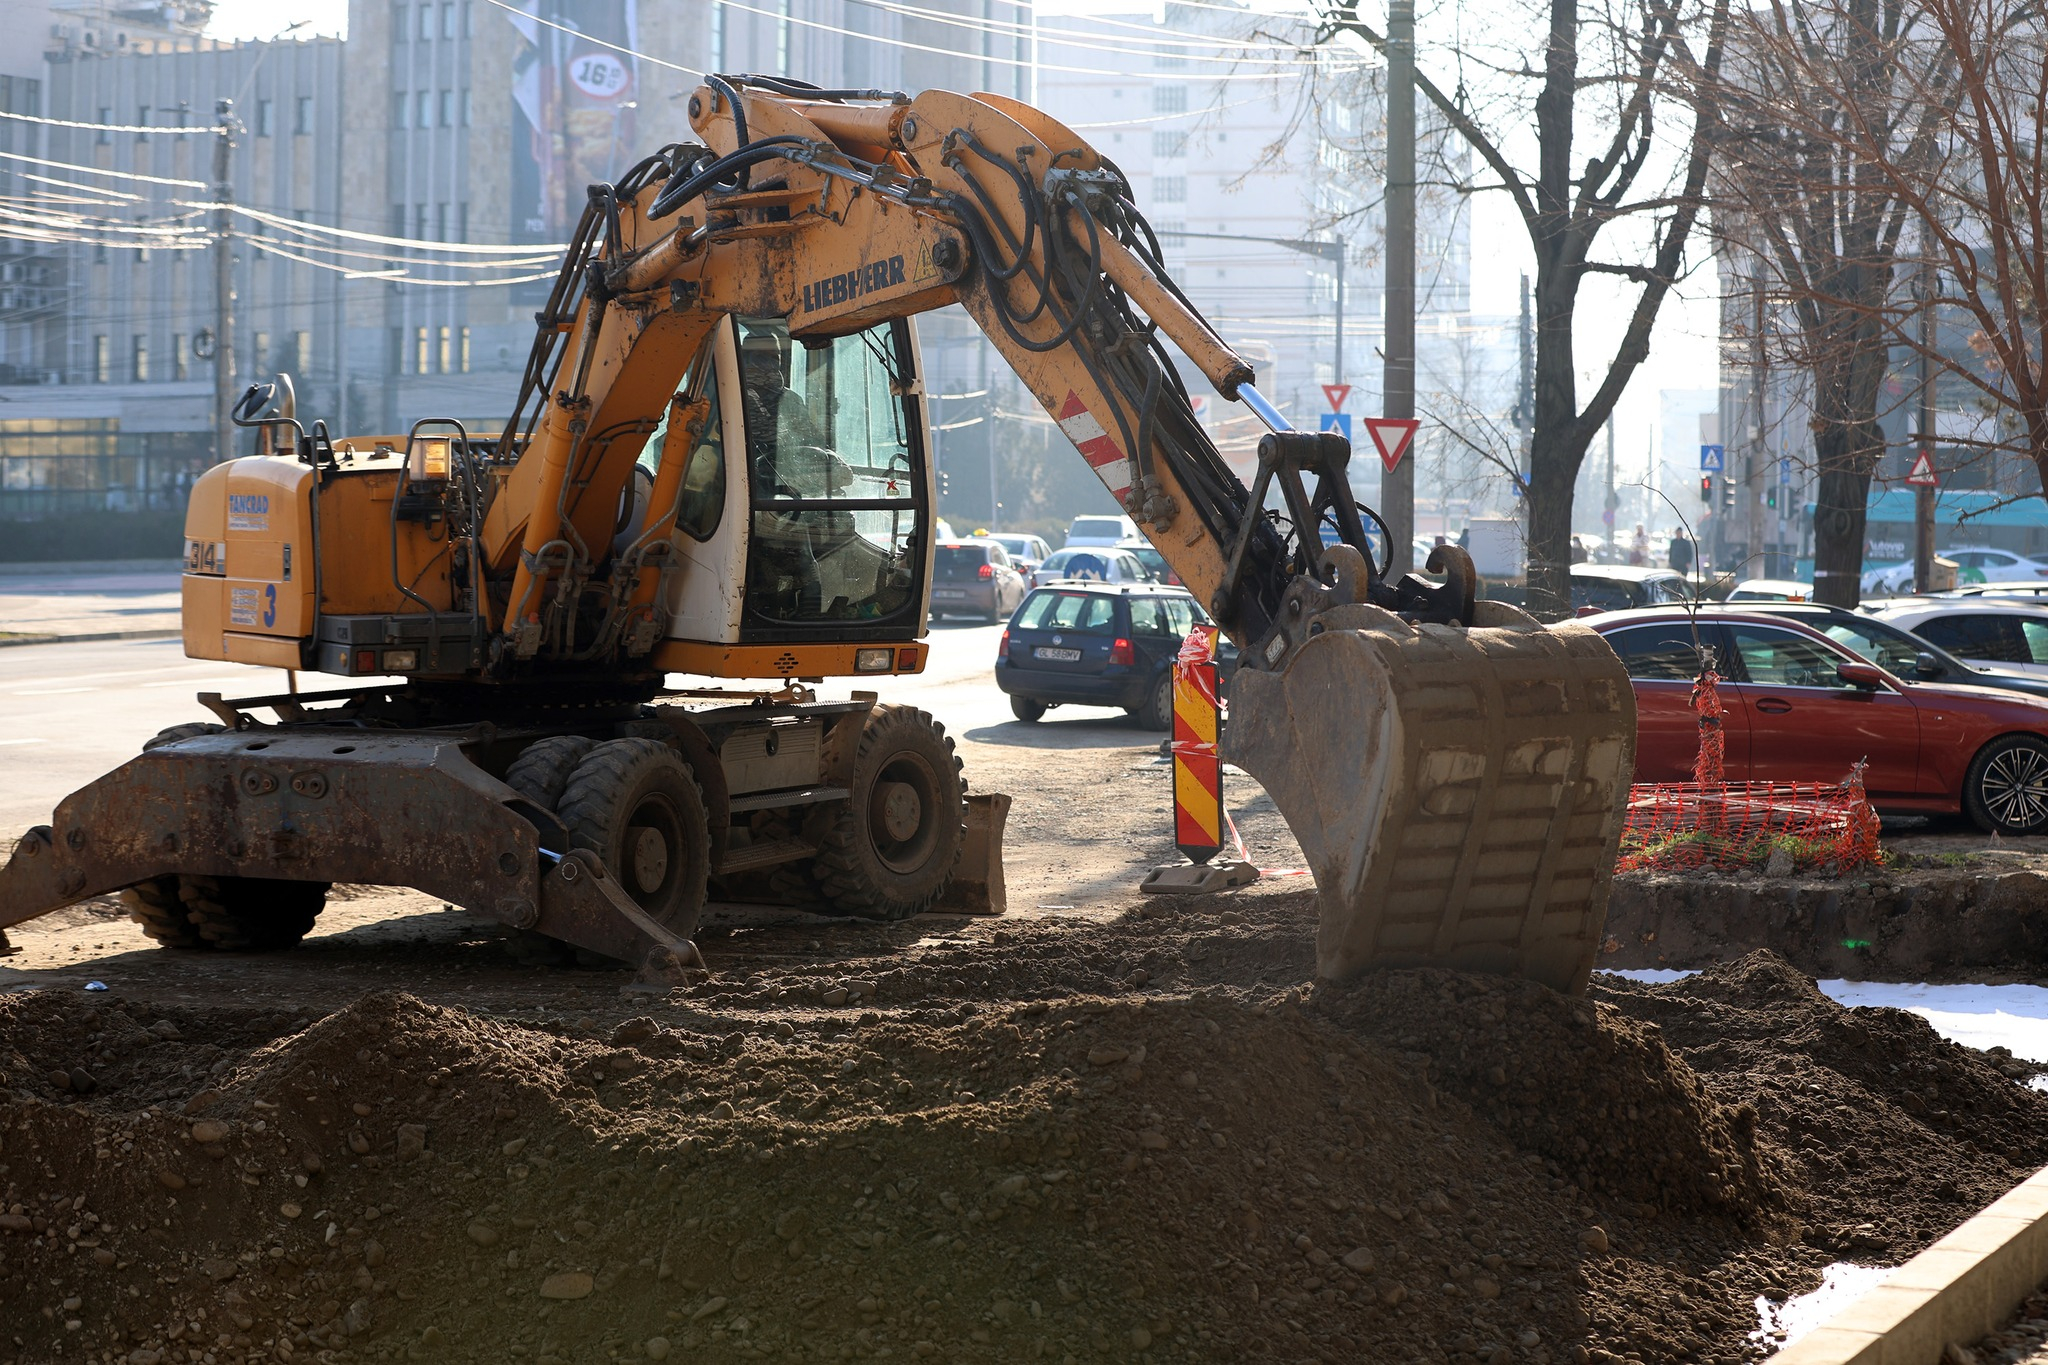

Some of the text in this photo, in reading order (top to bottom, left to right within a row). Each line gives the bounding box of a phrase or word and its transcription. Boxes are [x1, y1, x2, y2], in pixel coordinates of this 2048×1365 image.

[579, 62, 607, 86] 16
[803, 255, 906, 313] LIEBHERR
[191, 542, 215, 571] 314
[264, 583, 276, 628] 3
